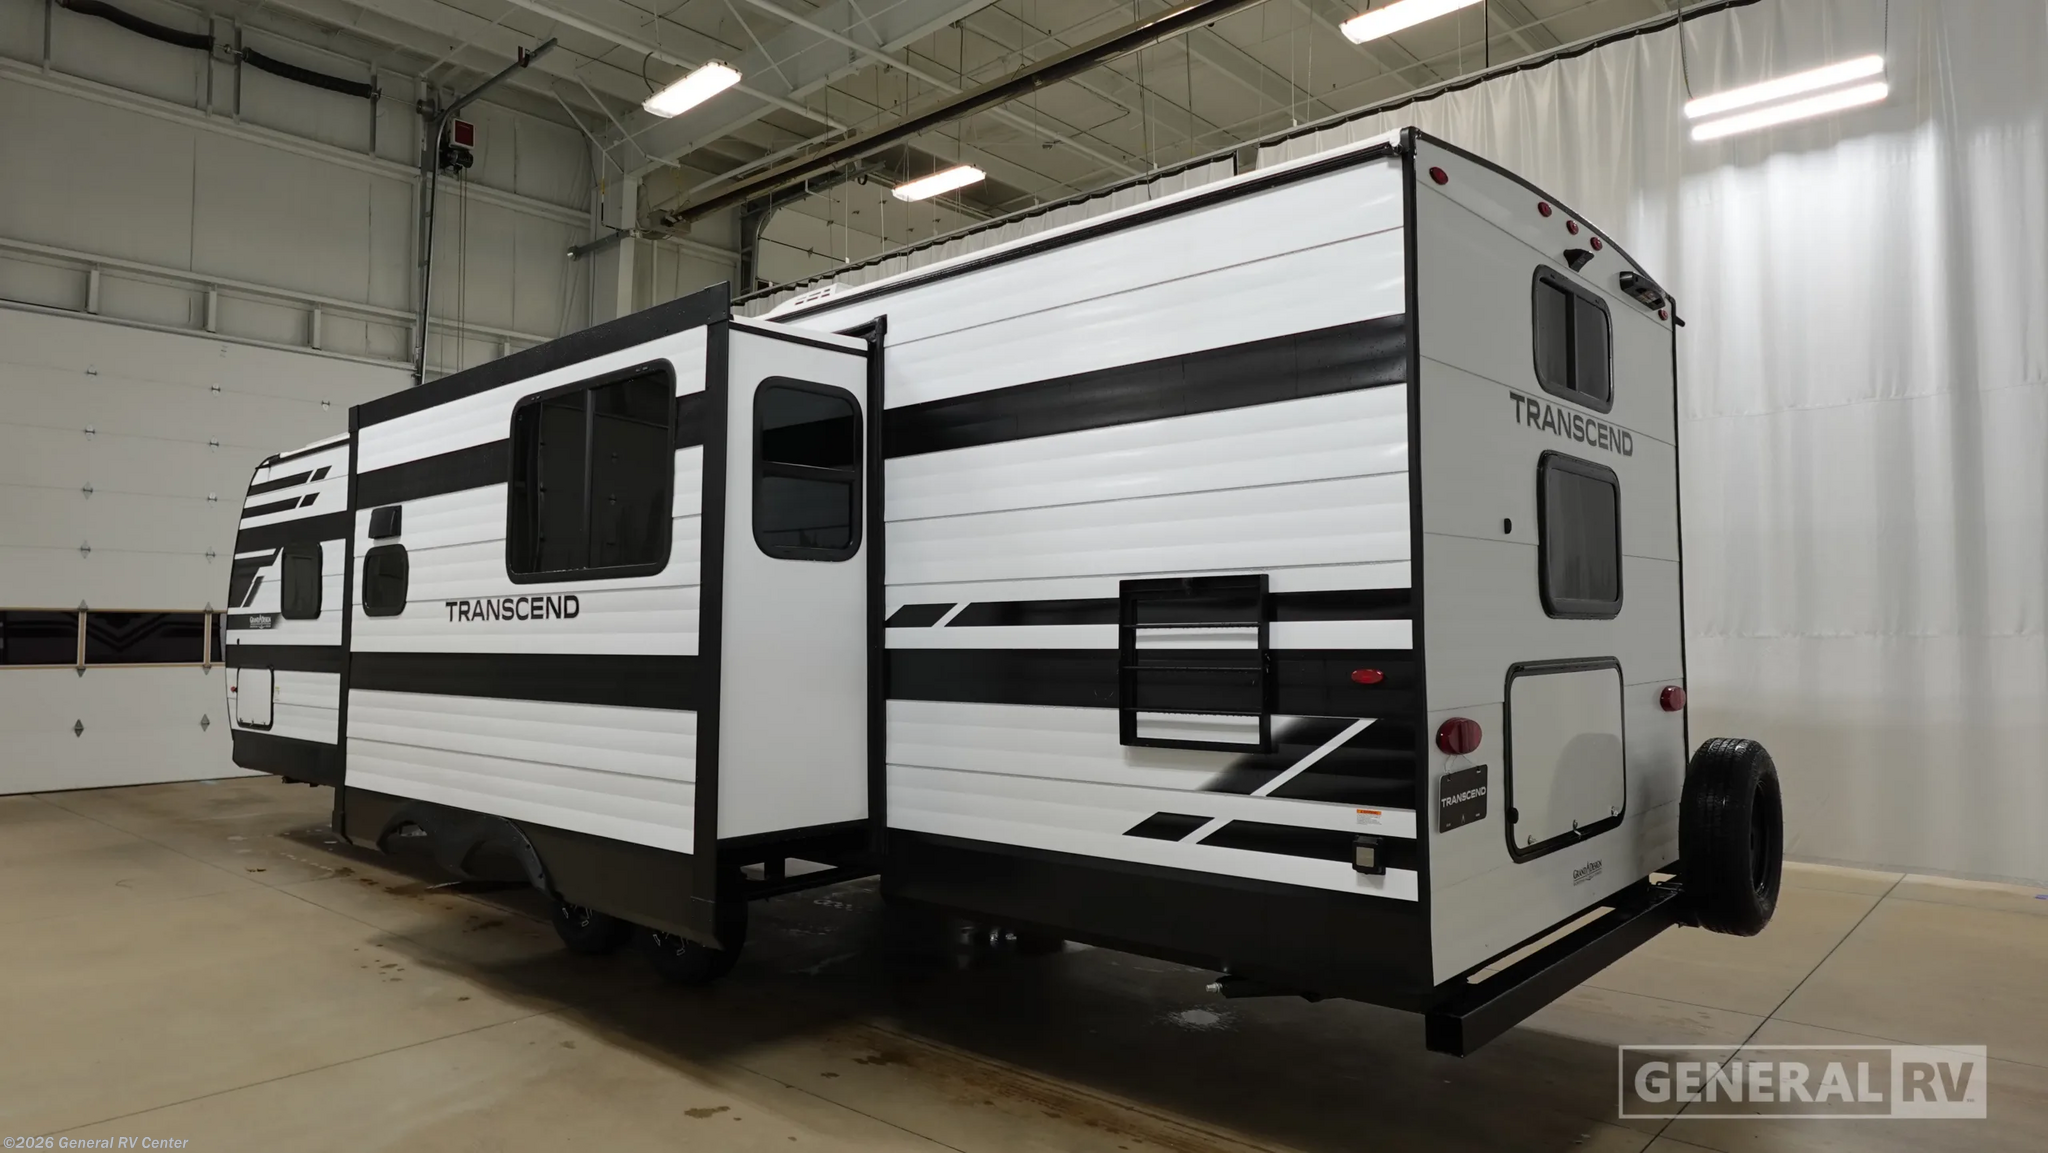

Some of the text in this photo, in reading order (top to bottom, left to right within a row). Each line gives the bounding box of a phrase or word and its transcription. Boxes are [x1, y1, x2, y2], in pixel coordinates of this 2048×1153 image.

[1509, 390, 1633, 457] TRANSCEND
[445, 595, 580, 622] TRANSCEND
[1441, 786, 1487, 808] TRANSCEND
